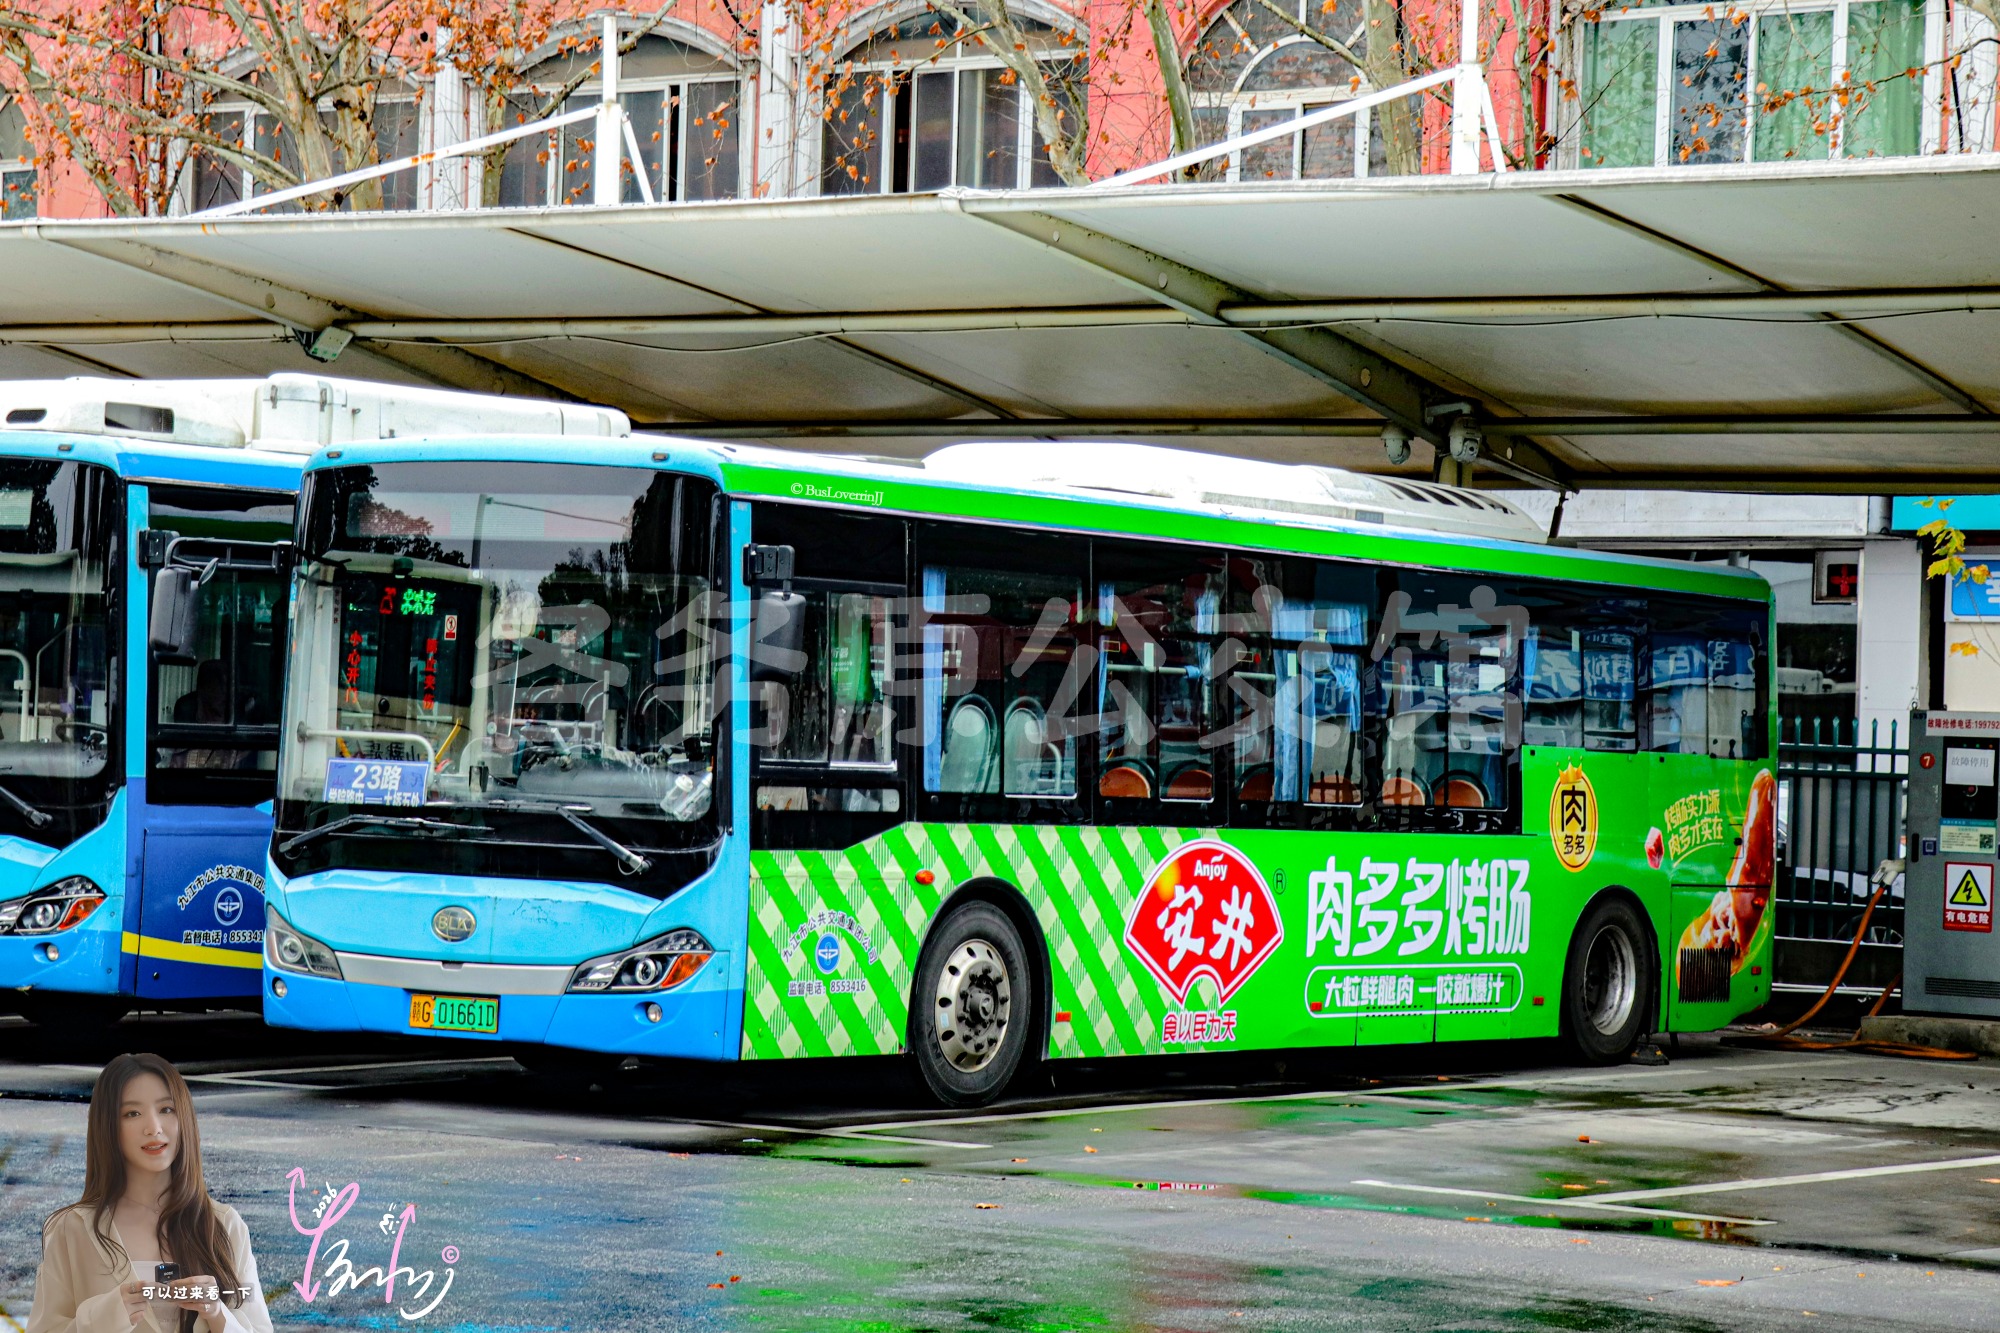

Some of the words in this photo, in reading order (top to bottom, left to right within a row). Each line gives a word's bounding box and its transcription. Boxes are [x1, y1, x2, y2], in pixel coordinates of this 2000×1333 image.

[351, 764, 401, 791] 23路
[1923, 755, 1931, 767] 7
[1951, 756, 1989, 768] 故障停用
[1561, 784, 1586, 832] 肉
[1664, 788, 1720, 834] 烤肠实力派
[1563, 834, 1585, 855] 多多
[1667, 815, 1723, 861] 肉多才实在
[1194, 853, 1228, 881] Anjoy
[437, 914, 470, 932] BLK
[1305, 855, 1532, 958] 肉多多烤肠
[1945, 911, 1989, 924] 有电危险
[782, 909, 878, 964] 九江市公共交通集团公司
[1156, 884, 1255, 972] 安井
[1324, 974, 1415, 1008] 大粒鲜腿肉
[1418, 972, 1505, 1005] 一咬就爆汁
[1162, 1010, 1238, 1043] 食以民为天
